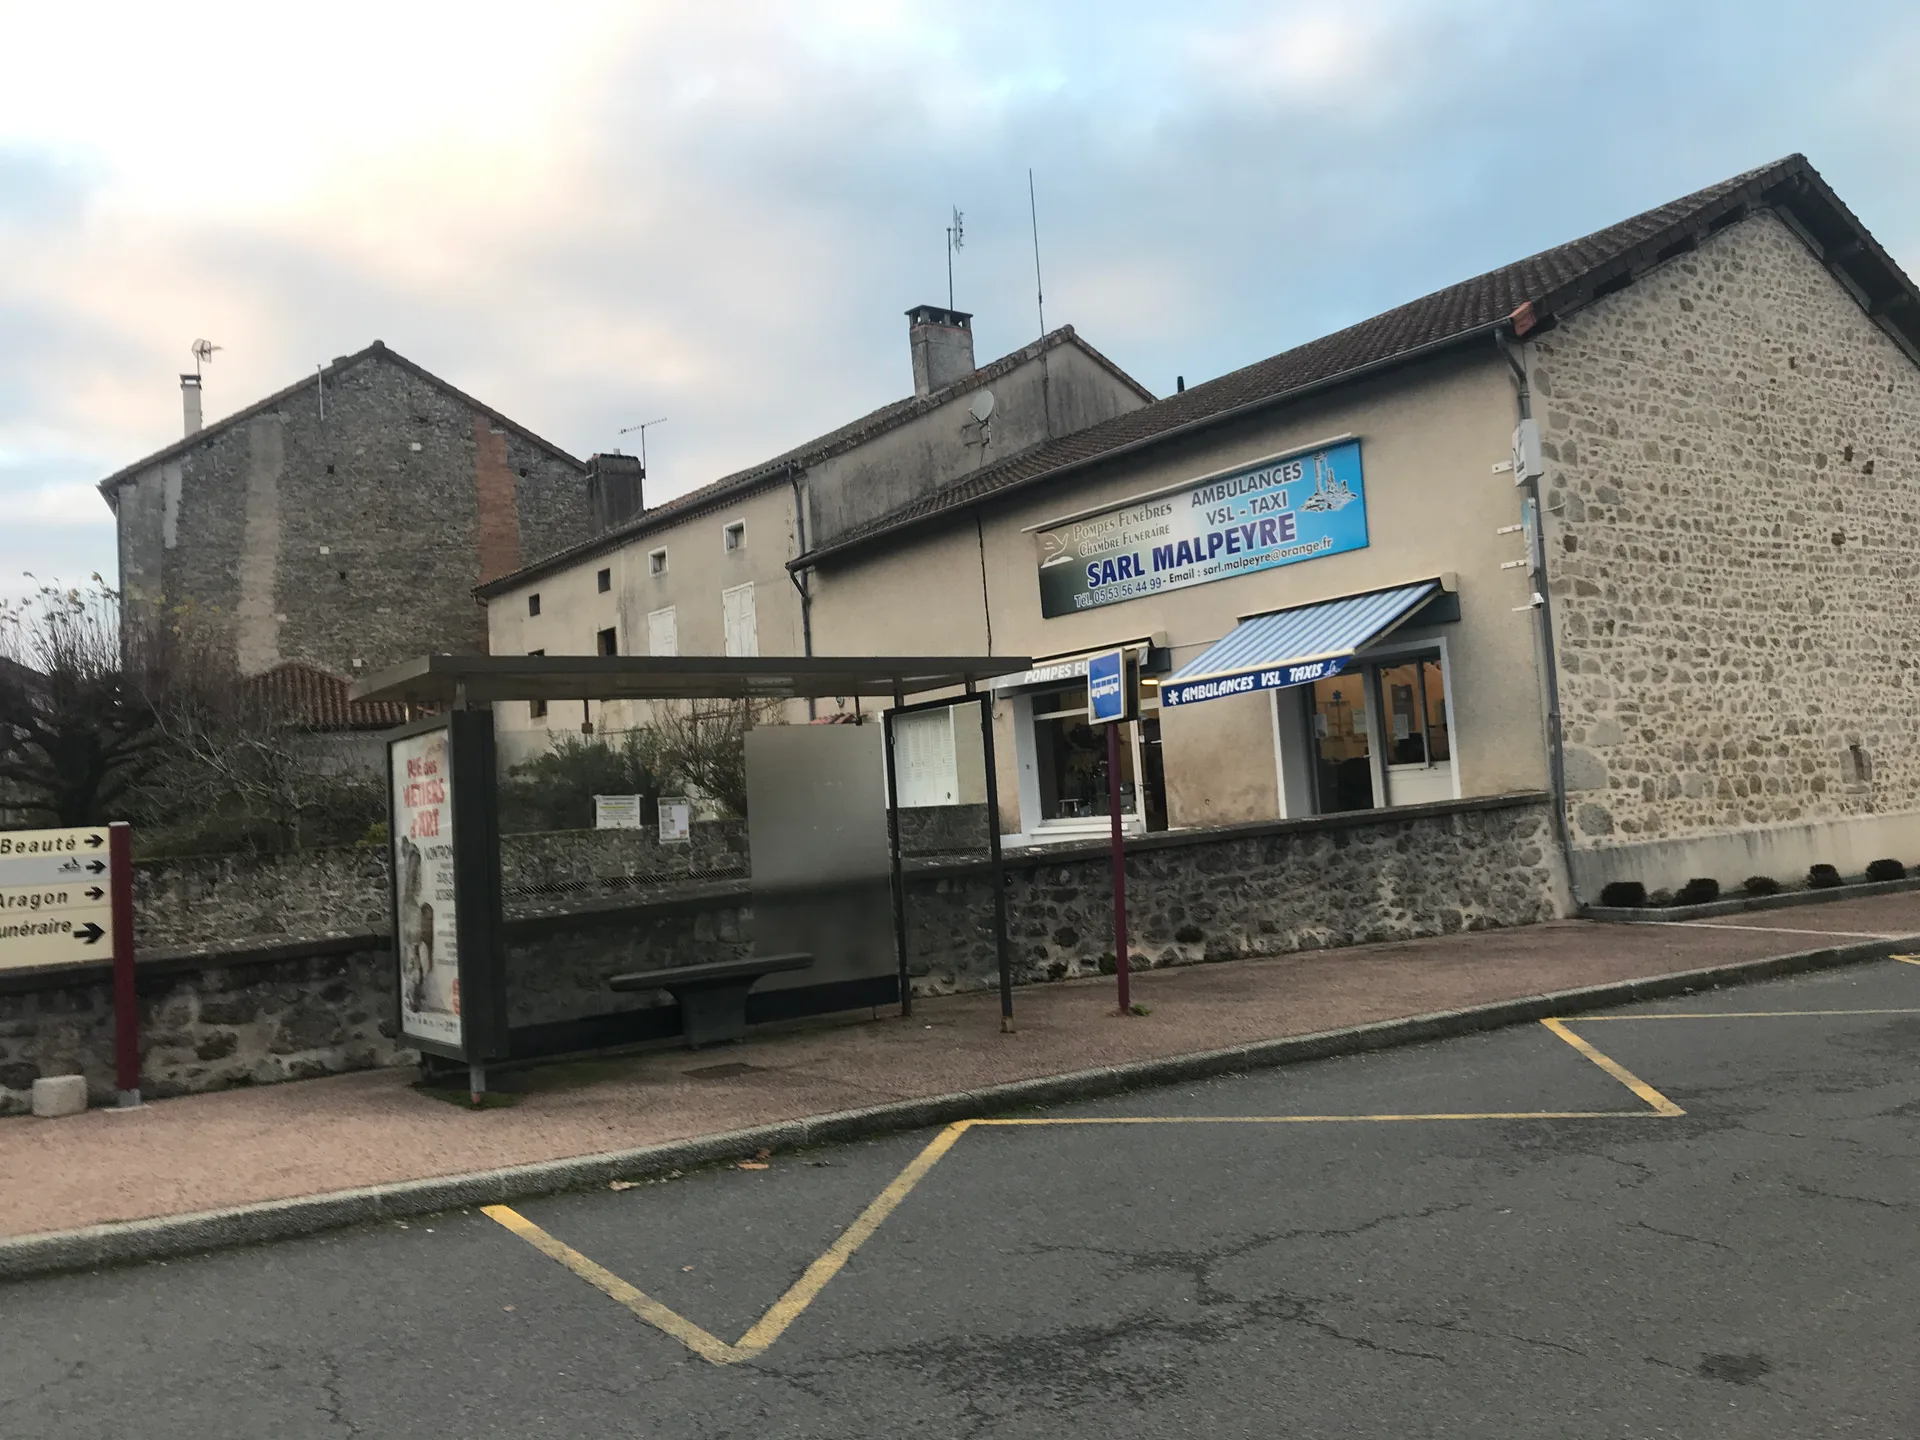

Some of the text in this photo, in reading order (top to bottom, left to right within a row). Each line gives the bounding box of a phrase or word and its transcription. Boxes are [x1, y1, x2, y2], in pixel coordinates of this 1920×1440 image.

[1191, 462, 1302, 508] AMBULANCES
[1206, 506, 1235, 526] VSL
[1249, 490, 1288, 515] TAXI
[1087, 513, 1296, 588] SARL MALPEYRE
[1094, 590, 1106, 603] 05
[1108, 586, 1119, 600] 53
[1122, 584, 1133, 596] 56
[1136, 580, 1147, 592] 44
[1149, 577, 1161, 590] 99
[1169, 567, 1195, 584] Email
[1203, 536, 1333, 577] sarl.malpeyre@orange.fr
[1024, 663, 1072, 684] POMPES
[1182, 663, 1324, 703] AMBULANCES VSL TAXIS
[0, 835, 76, 855] Beauté
